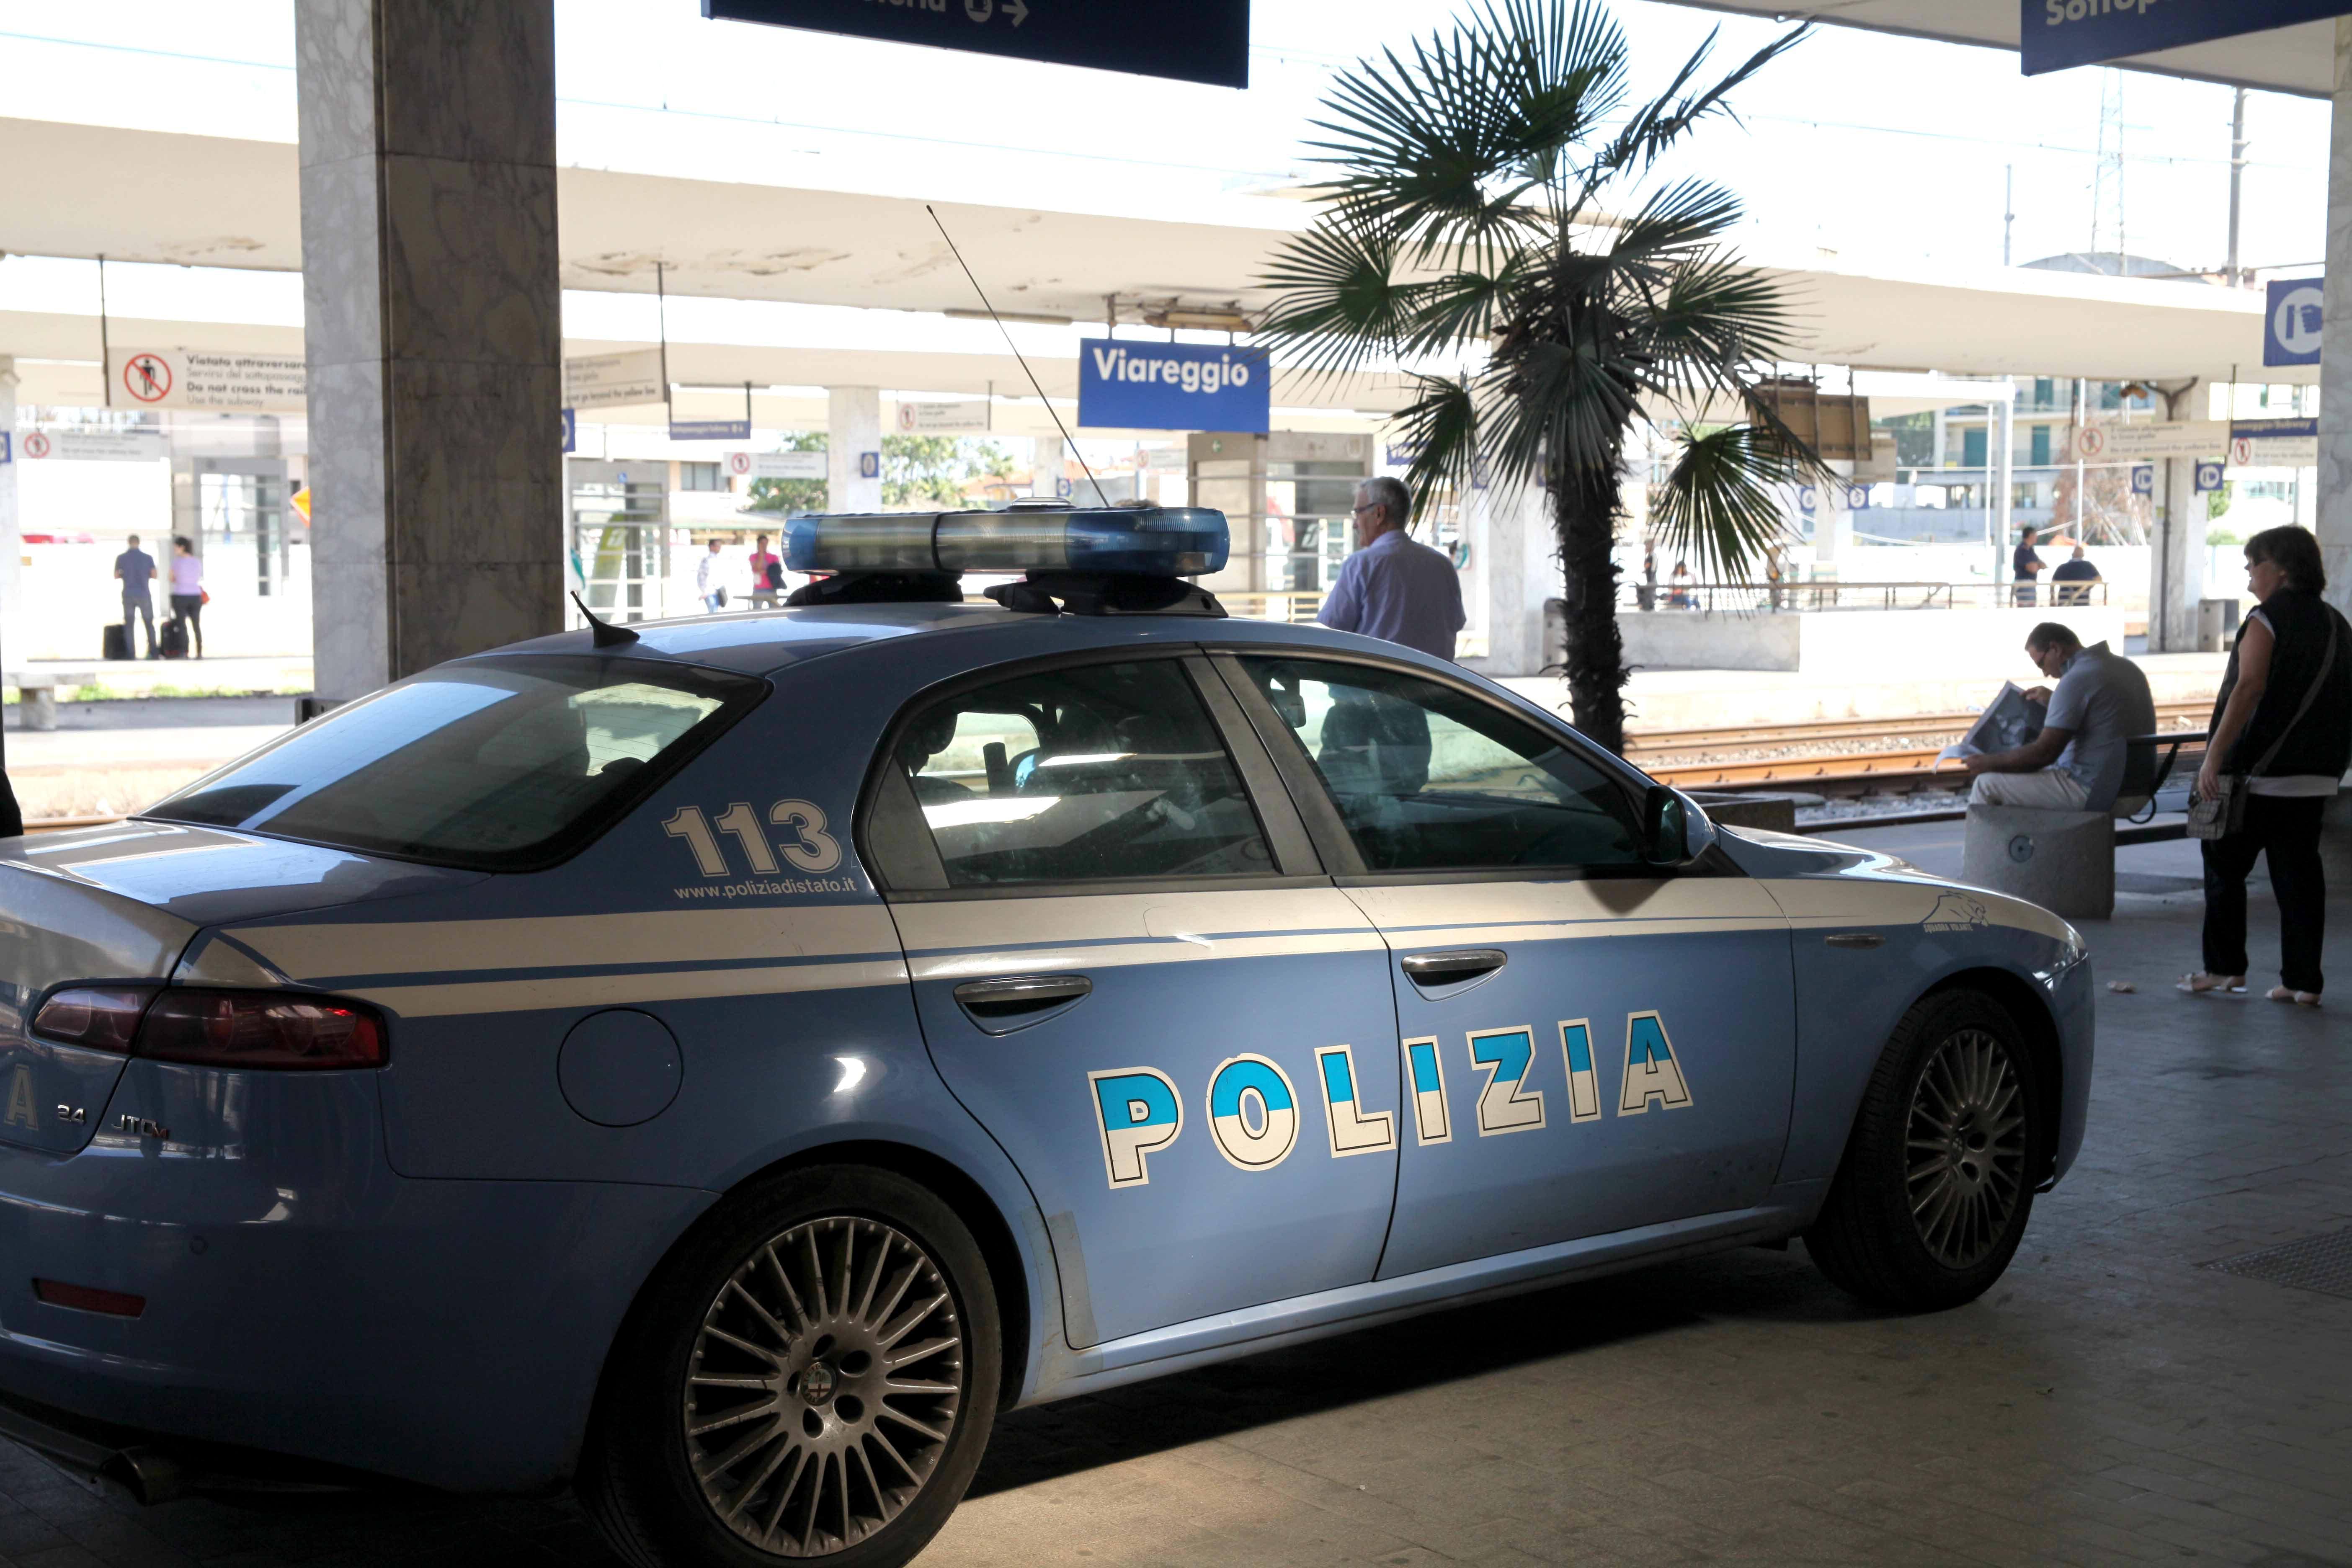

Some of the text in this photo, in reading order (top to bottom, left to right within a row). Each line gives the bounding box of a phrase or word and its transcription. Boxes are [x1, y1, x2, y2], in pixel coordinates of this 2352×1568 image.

[187, 355, 230, 366] Vietato
[1093, 348, 1248, 393] Viareggio
[187, 382, 203, 392] Do
[208, 384, 227, 393] not
[231, 385, 260, 394] cross
[266, 384, 283, 395] the
[661, 799, 841, 877] 113
[674, 877, 857, 899] www.poliziadistato.it
[3, 1064, 39, 1132] A
[1088, 1010, 1693, 1189] POLIZIA
